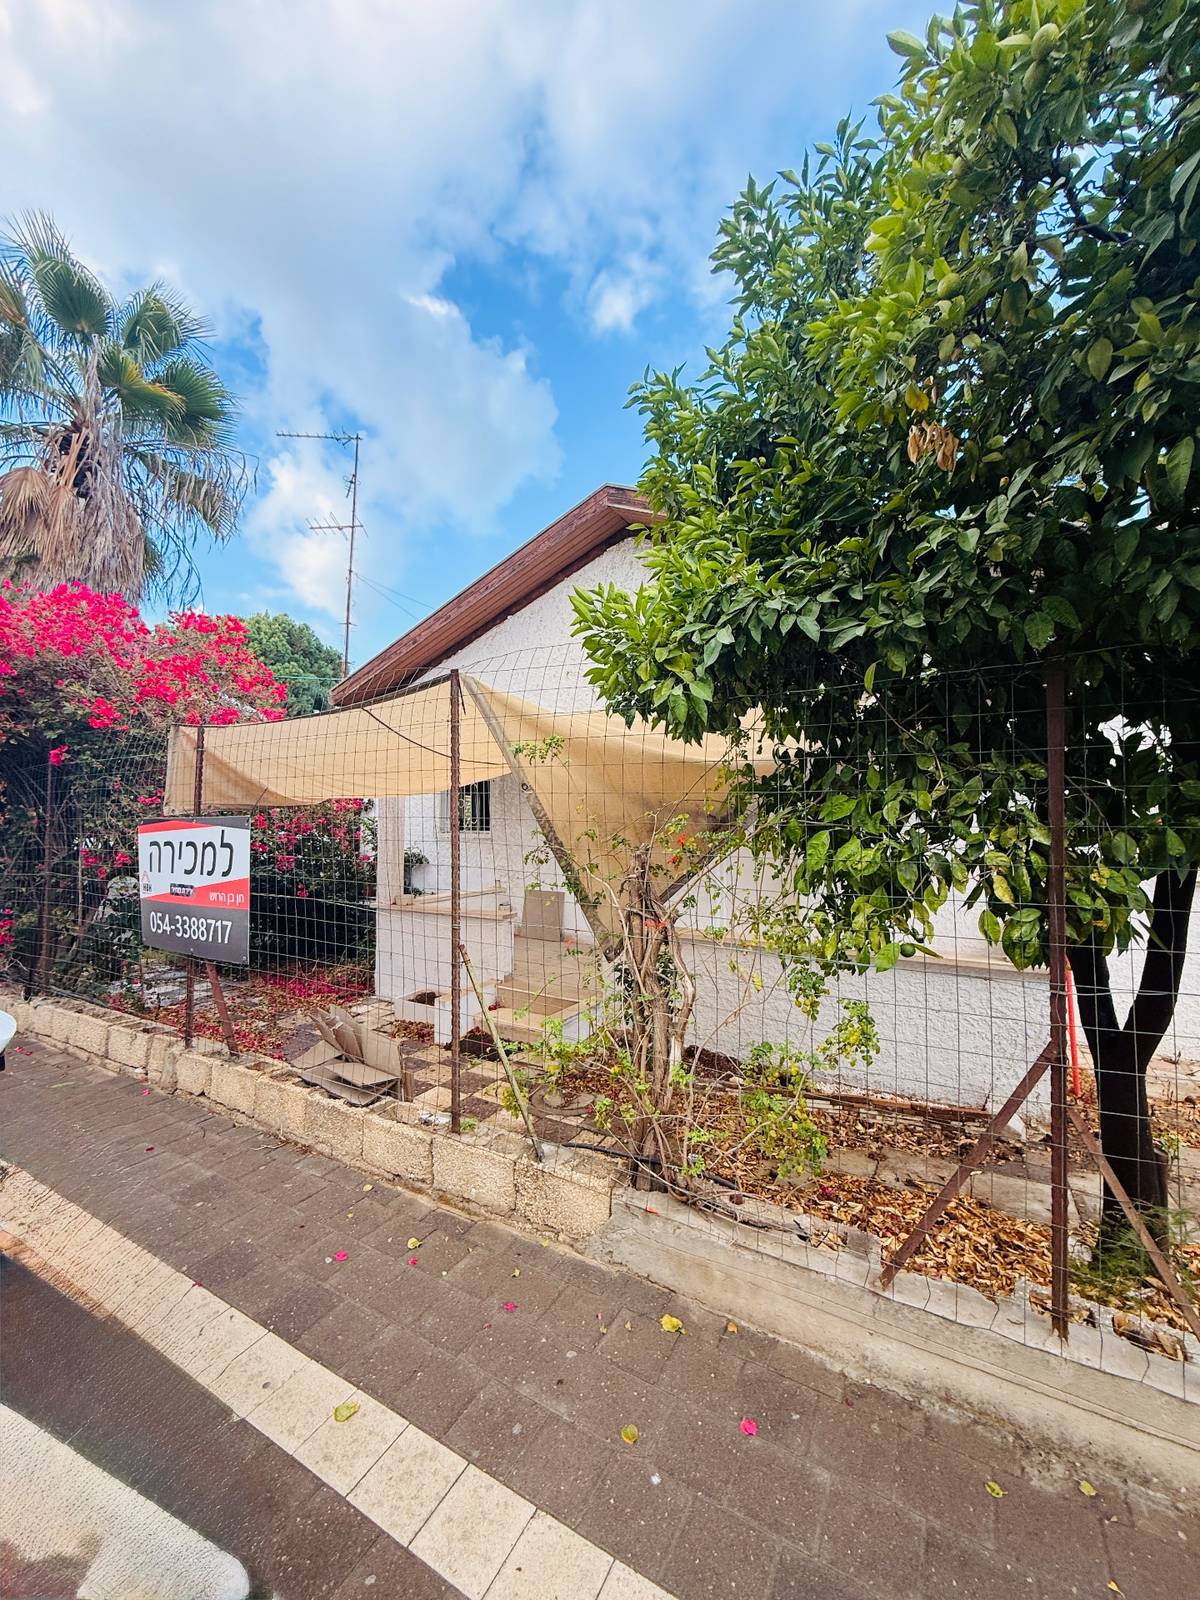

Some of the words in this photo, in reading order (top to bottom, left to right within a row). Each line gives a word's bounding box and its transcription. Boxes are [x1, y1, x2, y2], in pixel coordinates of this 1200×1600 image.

[149, 829, 234, 877] למכירה
[227, 893, 235, 905] בן
[236, 893, 245, 906] חן
[150, 911, 233, 944] 054-3388717
